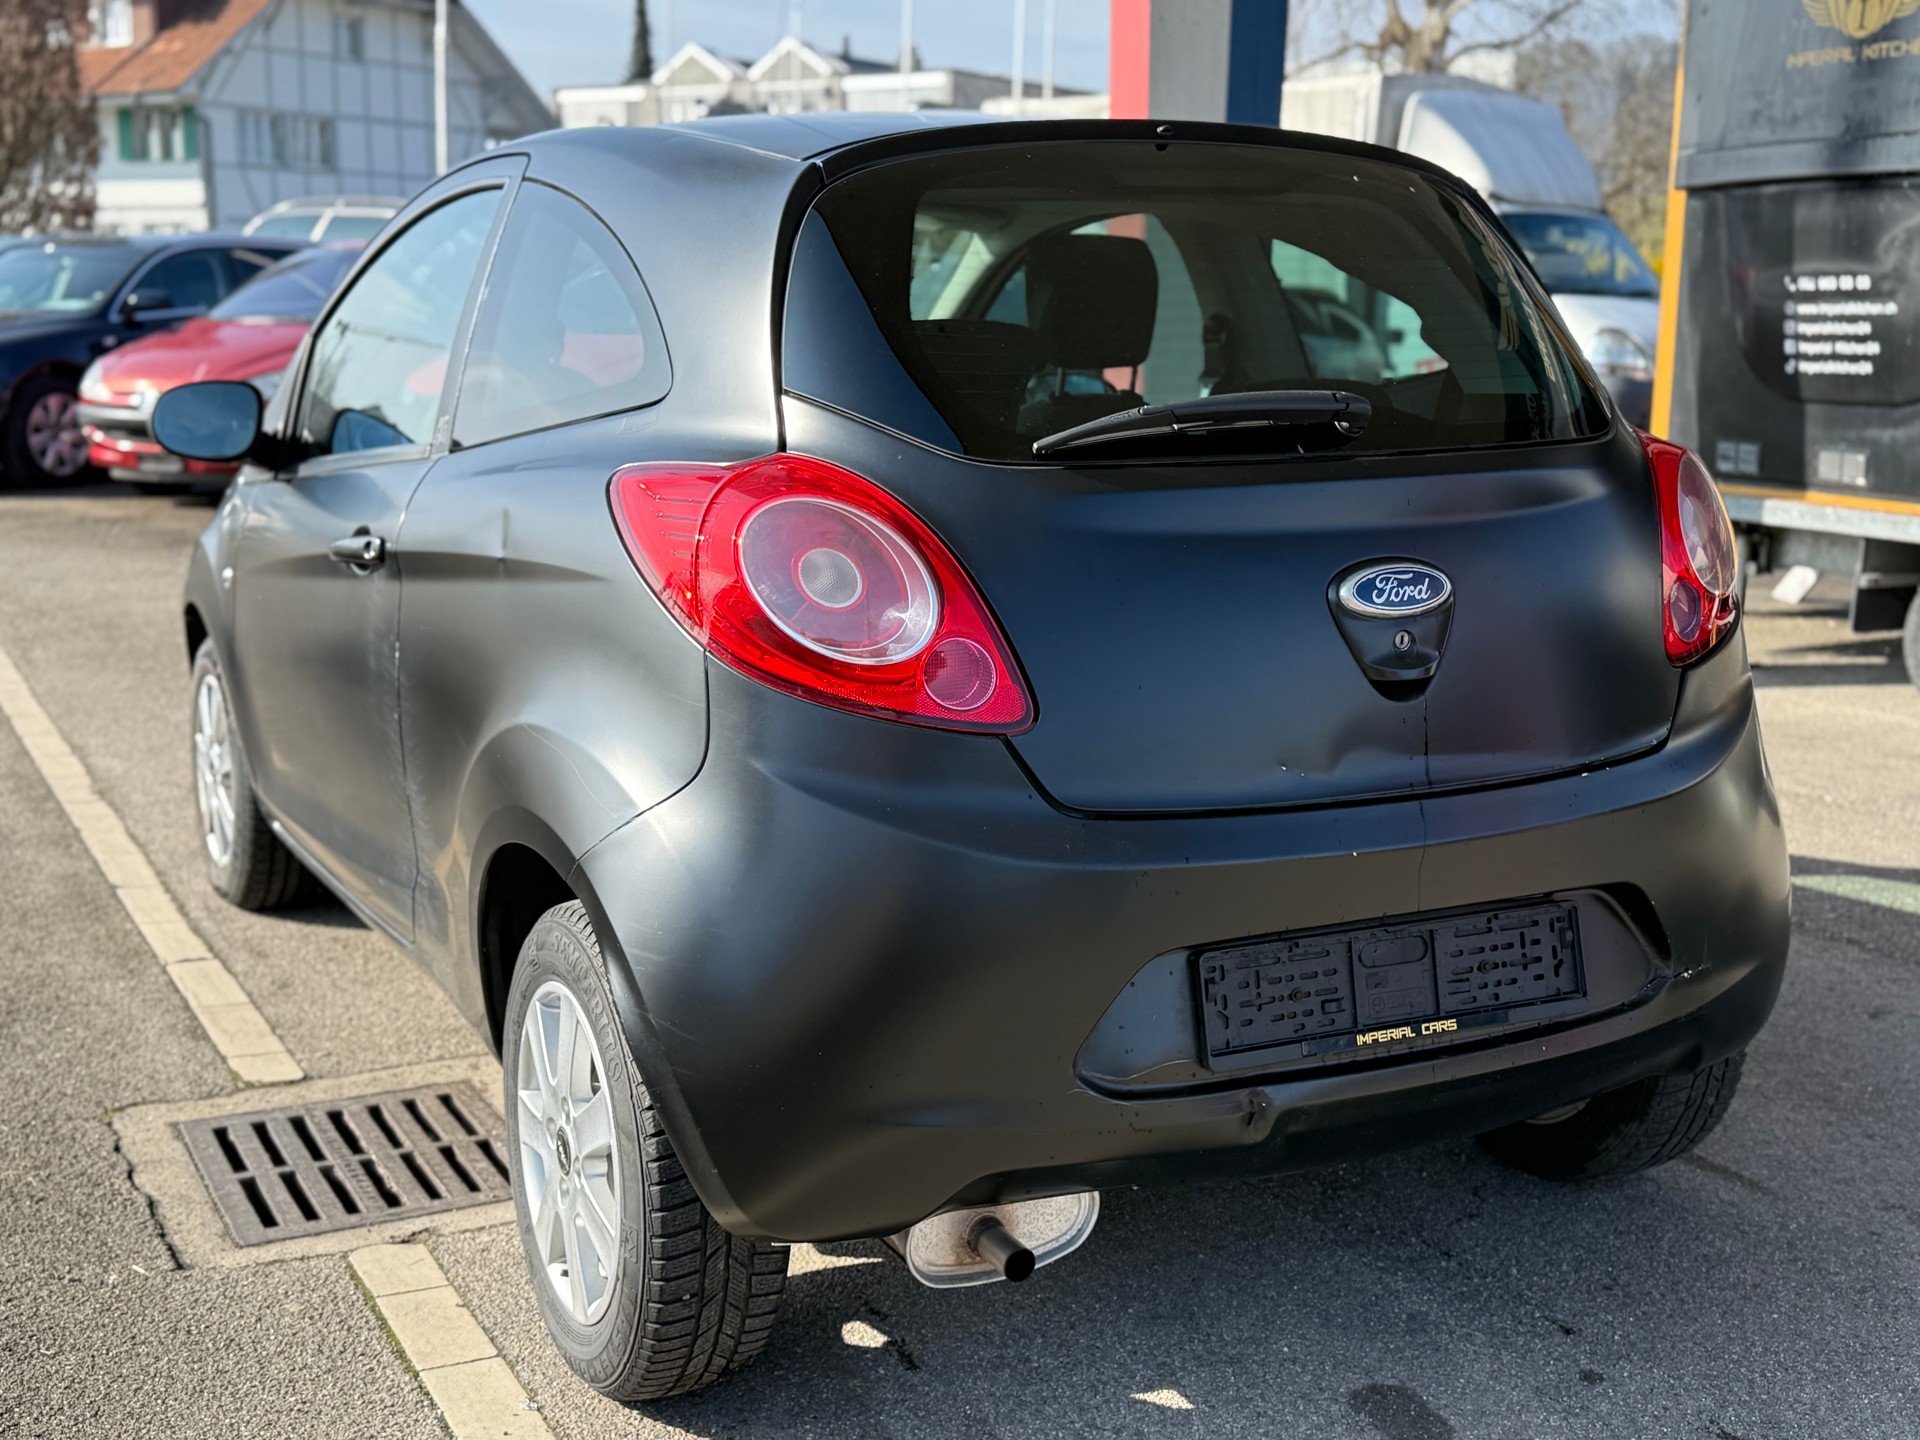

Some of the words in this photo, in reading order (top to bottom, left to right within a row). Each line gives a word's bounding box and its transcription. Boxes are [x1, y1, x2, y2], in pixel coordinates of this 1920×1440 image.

[1372, 573, 1431, 604] Ford
[1356, 1026, 1416, 1046] IMPERIAL
[1421, 1019, 1458, 1035] CARS
